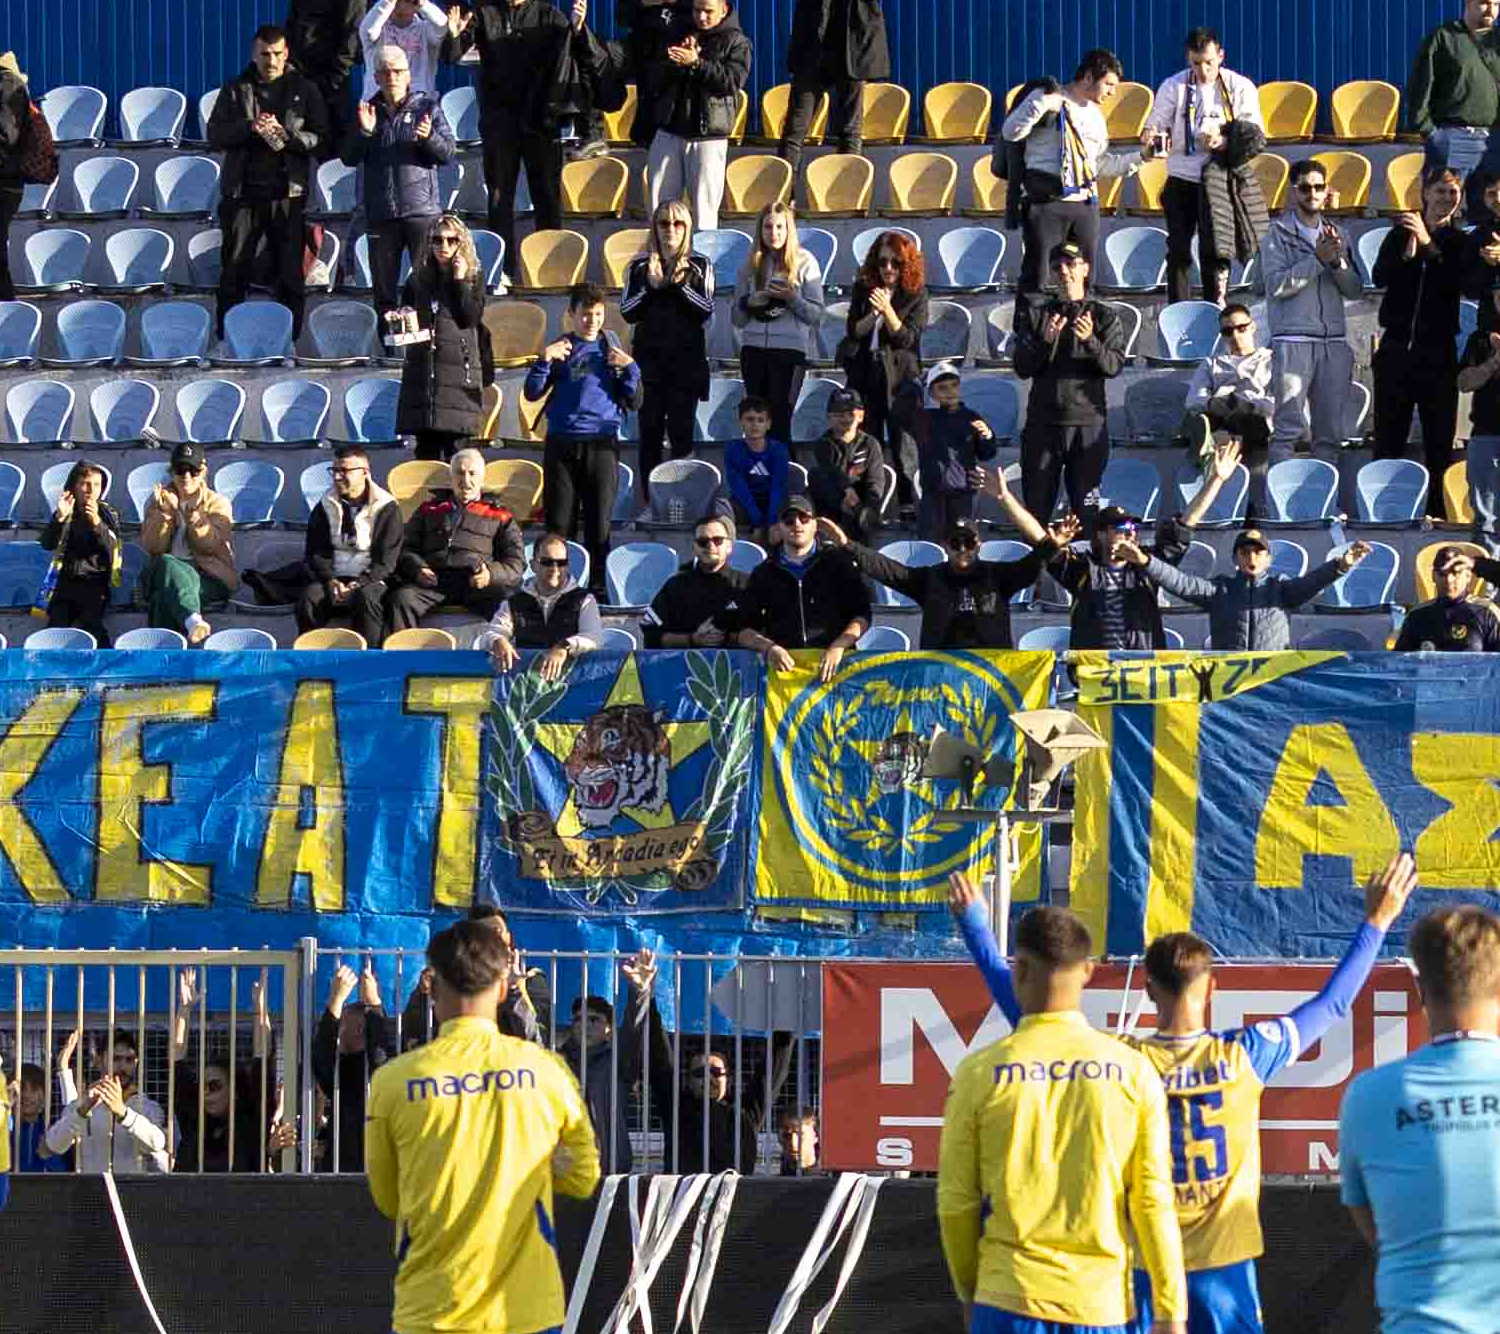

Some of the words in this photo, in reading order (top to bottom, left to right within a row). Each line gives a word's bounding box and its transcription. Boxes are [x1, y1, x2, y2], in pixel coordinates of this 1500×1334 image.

[406, 1068, 535, 1102] macron
[993, 1058, 1124, 1085] macron
[1167, 1089, 1229, 1185] 15
